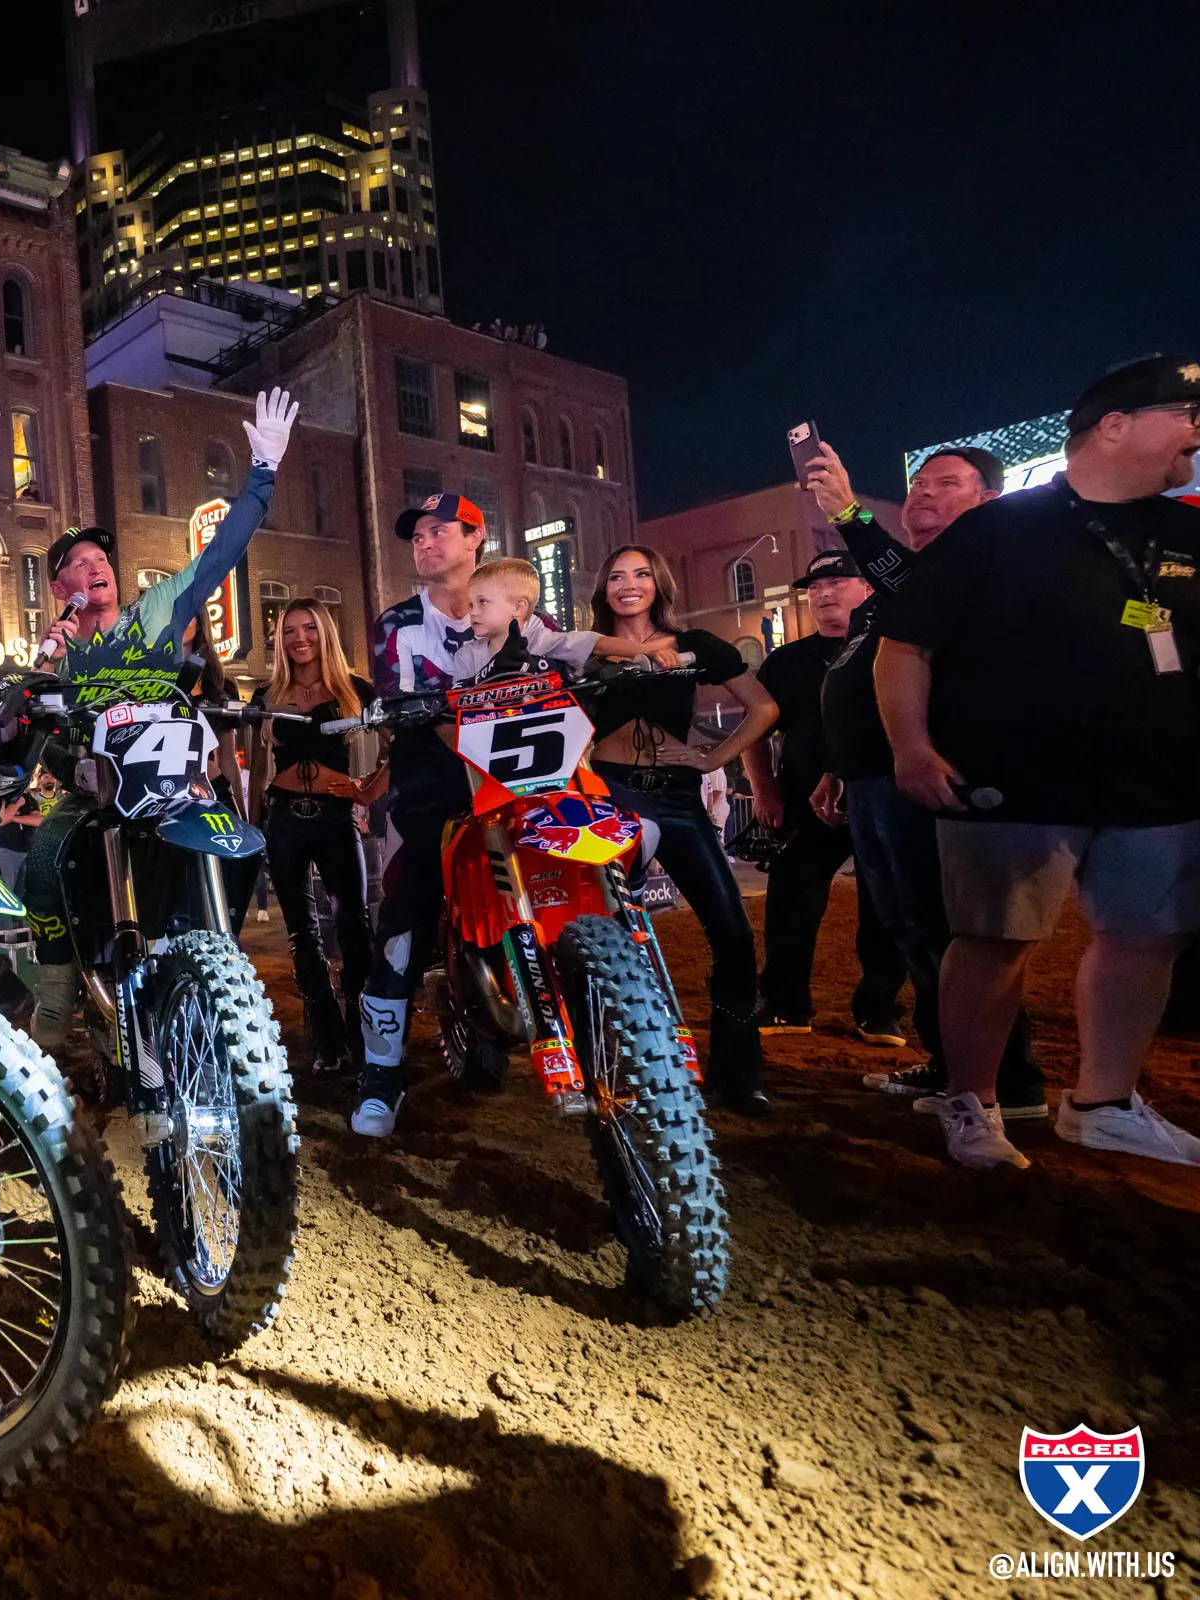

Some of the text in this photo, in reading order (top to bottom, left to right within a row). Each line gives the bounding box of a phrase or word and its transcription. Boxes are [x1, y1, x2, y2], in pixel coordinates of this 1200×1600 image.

[209, 5, 259, 32] AT&T
[27, 557, 36, 602] LIVE
[89, 667, 136, 681] Jeremy
[458, 680, 549, 707] RENTHAL
[123, 722, 199, 776] 4
[489, 713, 565, 784] 5
[508, 959, 533, 1030] MOTOREX
[523, 946, 560, 1032] DUNOP
[115, 982, 132, 1071] DUNLOP
[532, 1040, 571, 1051] ACERBS
